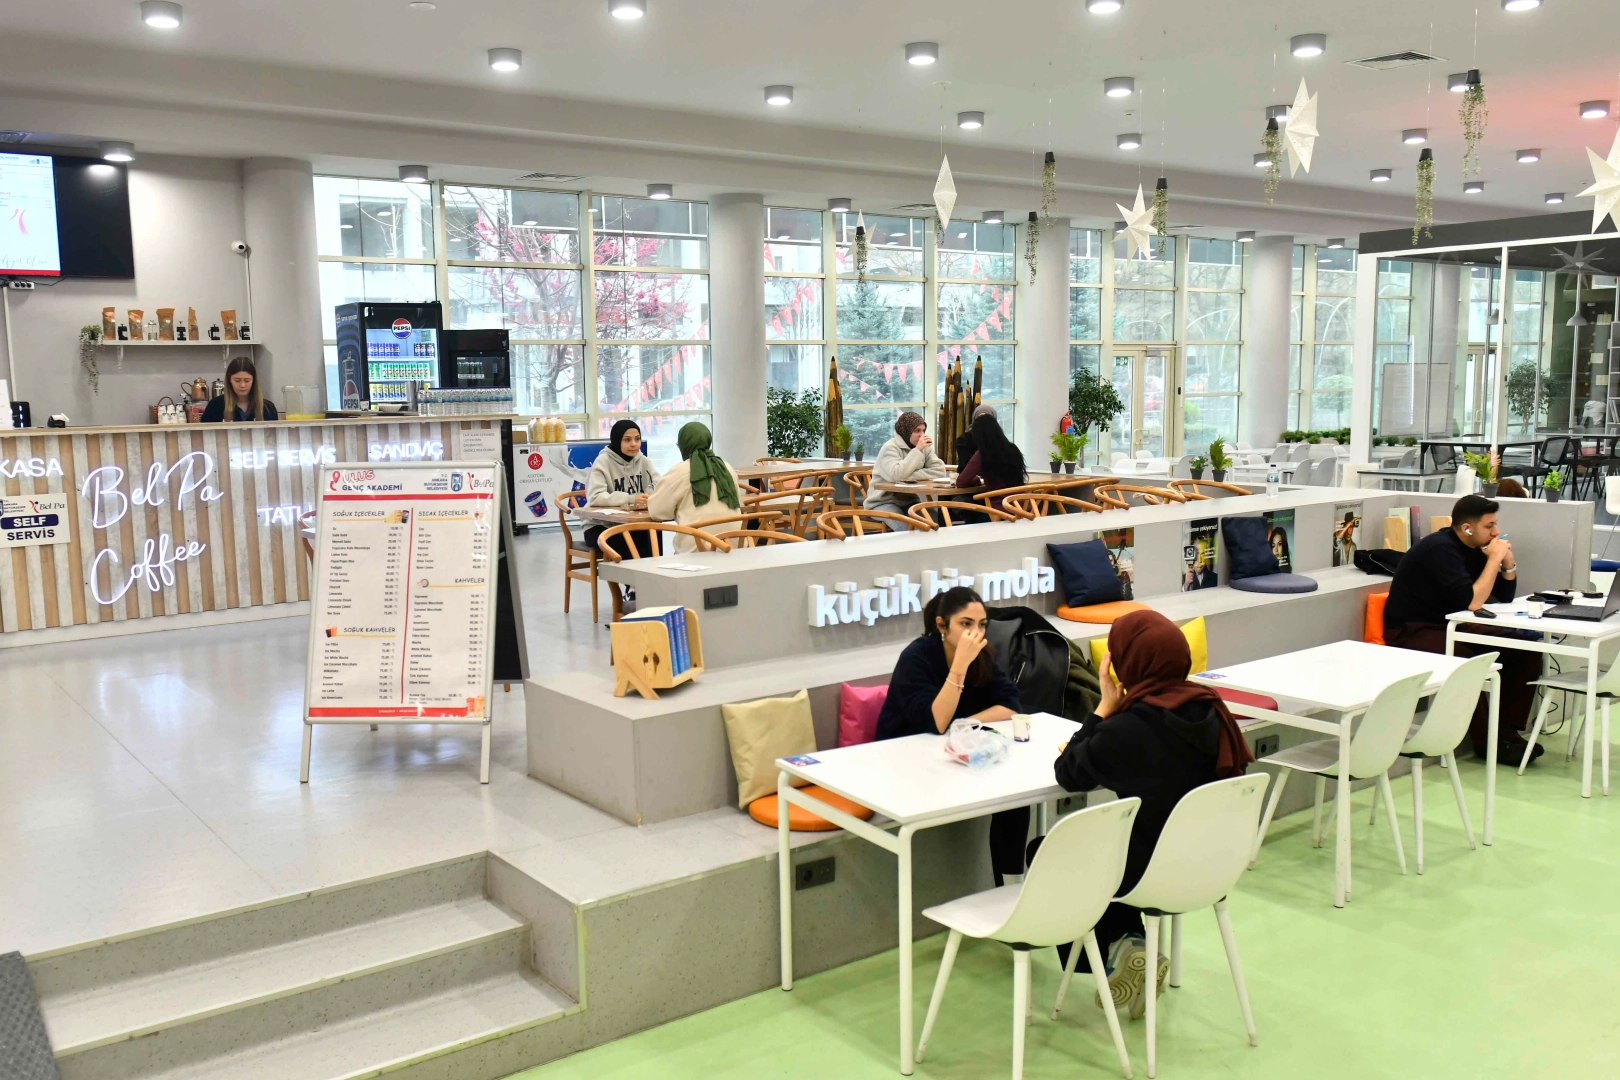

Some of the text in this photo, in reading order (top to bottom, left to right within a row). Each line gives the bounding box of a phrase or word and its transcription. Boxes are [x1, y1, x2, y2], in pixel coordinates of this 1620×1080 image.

[344, 398, 359, 409] PEPSI
[230, 450, 275, 469] SELF
[82, 451, 225, 529] Bel Pa
[342, 483, 403, 493] GENÇ AKADEMİ
[13, 516, 47, 528] SELF
[7, 528, 56, 541] SERVİS
[91, 533, 206, 605] Coffee
[808, 573, 922, 627] küçük
[976, 557, 1056, 602] mola
